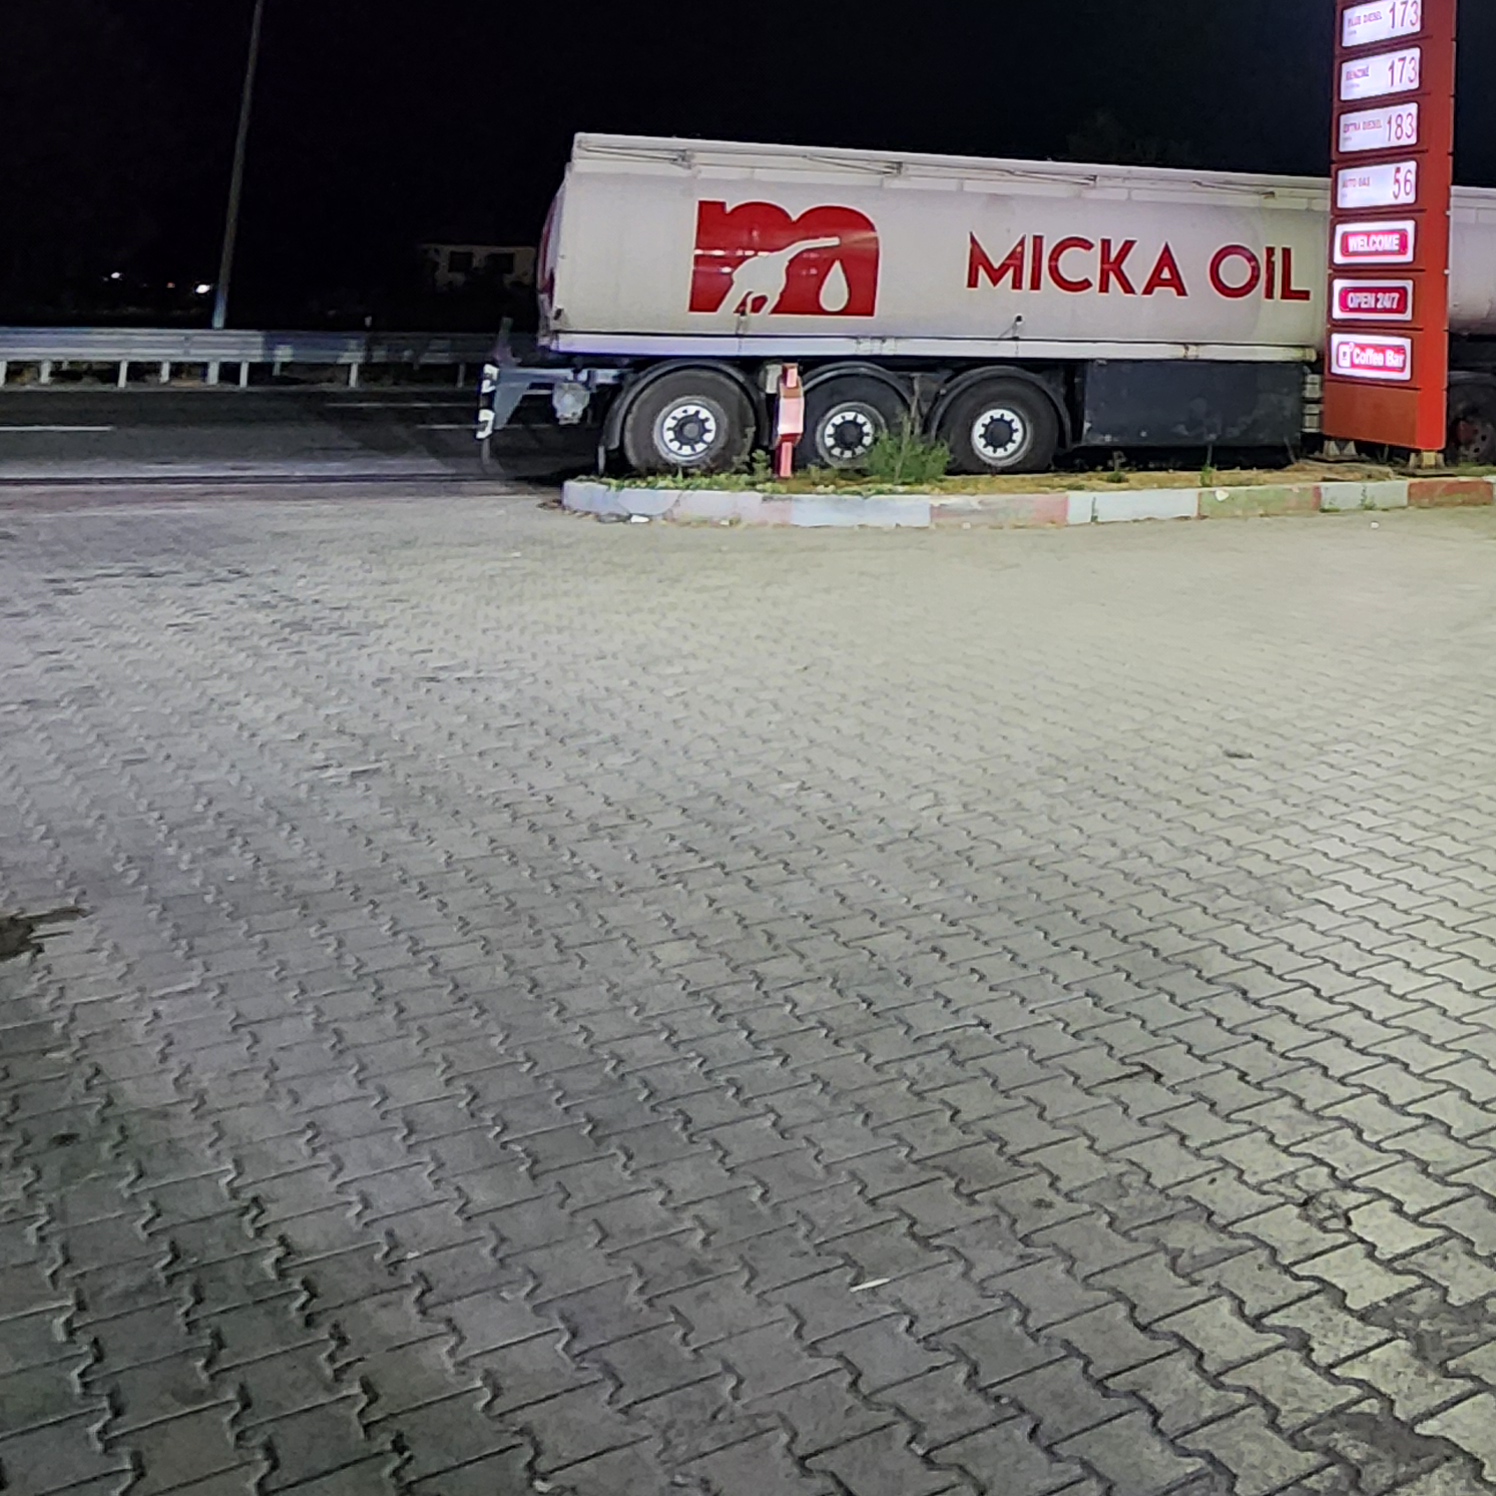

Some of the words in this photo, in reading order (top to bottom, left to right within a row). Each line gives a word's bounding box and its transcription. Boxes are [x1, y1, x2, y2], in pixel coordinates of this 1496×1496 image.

[1389, 0, 1419, 29] 173
[1388, 56, 1417, 87] 173
[1387, 112, 1415, 142] 183
[1347, 233, 1400, 252] WELCOME
[966, 230, 1188, 297] MICKA
[1208, 243, 1311, 301] OIL
[1347, 292, 1376, 309] OPEN
[1352, 346, 1384, 366] Coffee
[1385, 349, 1405, 368] Bar
